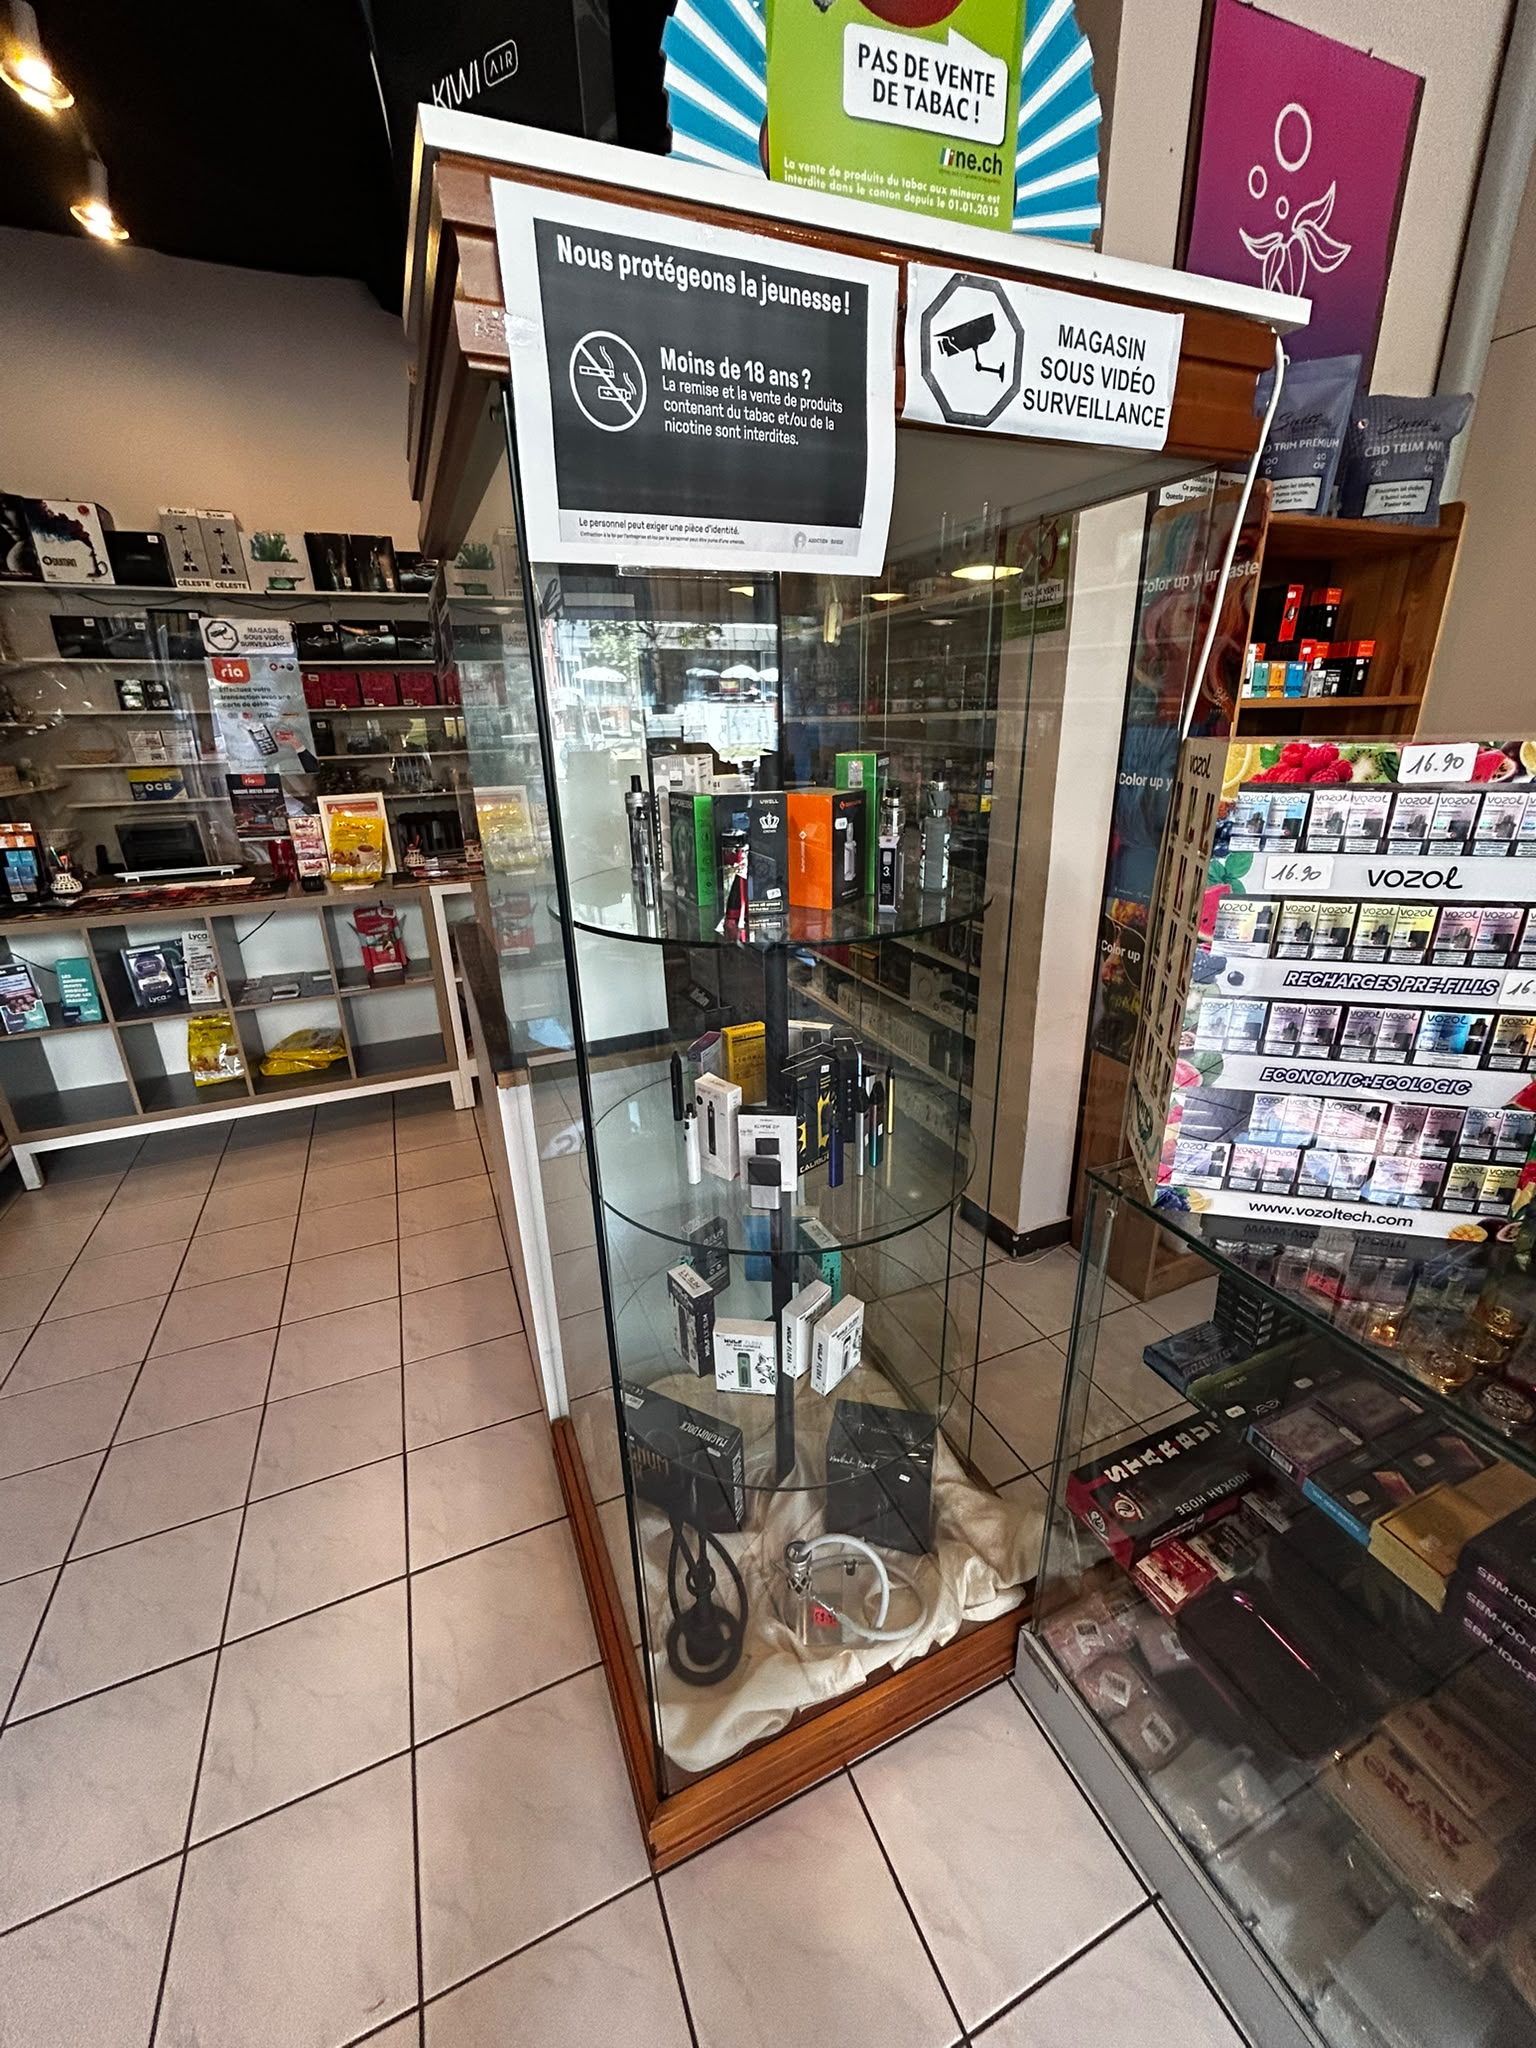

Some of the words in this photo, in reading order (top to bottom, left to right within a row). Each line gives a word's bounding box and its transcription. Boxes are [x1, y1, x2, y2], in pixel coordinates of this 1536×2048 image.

[432, 60, 480, 108] KIWI
[489, 49, 514, 77] AIR
[858, 43, 898, 75] PAS
[904, 53, 930, 82] DE
[934, 60, 996, 97] VENTE
[873, 78, 898, 107] DE
[783, 156, 795, 169] La
[798, 163, 826, 175] vente
[829, 165, 841, 177] de
[844, 169, 884, 185] produits
[887, 174, 899, 187] du
[902, 177, 927, 192] tabac
[930, 184, 947, 195] aux
[950, 185, 985, 202] mineurs
[987, 194, 1000, 204] est
[784, 171, 825, 189] interdite
[829, 178, 853, 194] dans
[856, 183, 865, 195] le
[869, 186, 901, 200] canton
[904, 191, 934, 207] depuis
[937, 196, 945, 208] le
[948, 199, 1000, 217] 01.01.2015
[556, 234, 613, 271] Nous
[618, 254, 736, 293] protégeons
[741, 270, 758, 298] la
[1058, 324, 1146, 361] MAGASIN
[660, 347, 715, 377] Moins
[719, 356, 741, 380] de
[744, 360, 765, 384] 18
[1040, 356, 1094, 386] SOUS
[1101, 366, 1155, 395] VIDÉO
[662, 375, 676, 392] La
[679, 380, 719, 398] remise
[722, 385, 735, 400] et
[737, 385, 748, 401] la
[750, 391, 780, 405] vente
[784, 393, 797, 408] de
[800, 396, 843, 414] produits
[664, 400, 724, 418] contenant
[727, 404, 741, 419] du
[744, 406, 775, 424] tabac
[778, 411, 807, 428] et/ou
[810, 415, 823, 430] de
[825, 416, 835, 431] la
[1023, 388, 1165, 428] SURVEILLANCE
[665, 417, 712, 436] nicotine
[715, 423, 741, 439] sont
[744, 425, 799, 446] interdites.
[1275, 441, 1297, 451] TRIM
[1299, 438, 1340, 449] PREMIUM
[1364, 446, 1390, 457] CBD
[1393, 441, 1423, 454] TRIM
[579, 517, 588, 527] Le
[589, 519, 626, 529] personnel
[628, 521, 645, 531] peut
[646, 521, 668, 533] exiger
[669, 524, 683, 532] une
[684, 523, 703, 534] pièce
[177, 579, 210, 588] CÉLESTE
[1174, 574, 1190, 591] up
[1192, 568, 1219, 588] yur
[1227, 561, 1260, 579] aste
[215, 581, 247, 589] CÉLESTE
[221, 663, 244, 678] ria
[1406, 752, 1465, 774] 16.90
[145, 781, 173, 792] OCB
[1119, 772, 1147, 787] Color
[1150, 776, 1163, 791] up
[1400, 796, 1435, 805] VOZOL
[1441, 796, 1477, 805] VOZOL
[1488, 795, 1525, 804] VOZOL
[1271, 864, 1323, 881] 16.90
[1367, 866, 1463, 890] VOZOL
[1219, 902, 1255, 913] VOZOL
[1285, 904, 1318, 913] VOZOL
[1321, 905, 1354, 915] VOZOL
[1363, 906, 1396, 916] VOZOL
[1400, 907, 1435, 918] VOZOL
[1444, 909, 1480, 919] VOZOL
[1485, 910, 1520, 919] VOZOL
[188, 933, 208, 941] Lyca
[1101, 939, 1125, 958] Color
[1127, 947, 1140, 963] up
[1284, 970, 1399, 992] RECHARGES
[1401, 975, 1499, 997] PRE-FILLS
[148, 995, 167, 1003] Lyca
[1308, 1006, 1338, 1016] VOZOL
[1385, 1012, 1417, 1021] VOZOL
[1427, 1014, 1469, 1025] VOZOL
[1249, 1201, 1413, 1228] www.vozoltech.com
[1209, 1471, 1251, 1498] HOOKAH
[1175, 1494, 1207, 1516] HOSE
